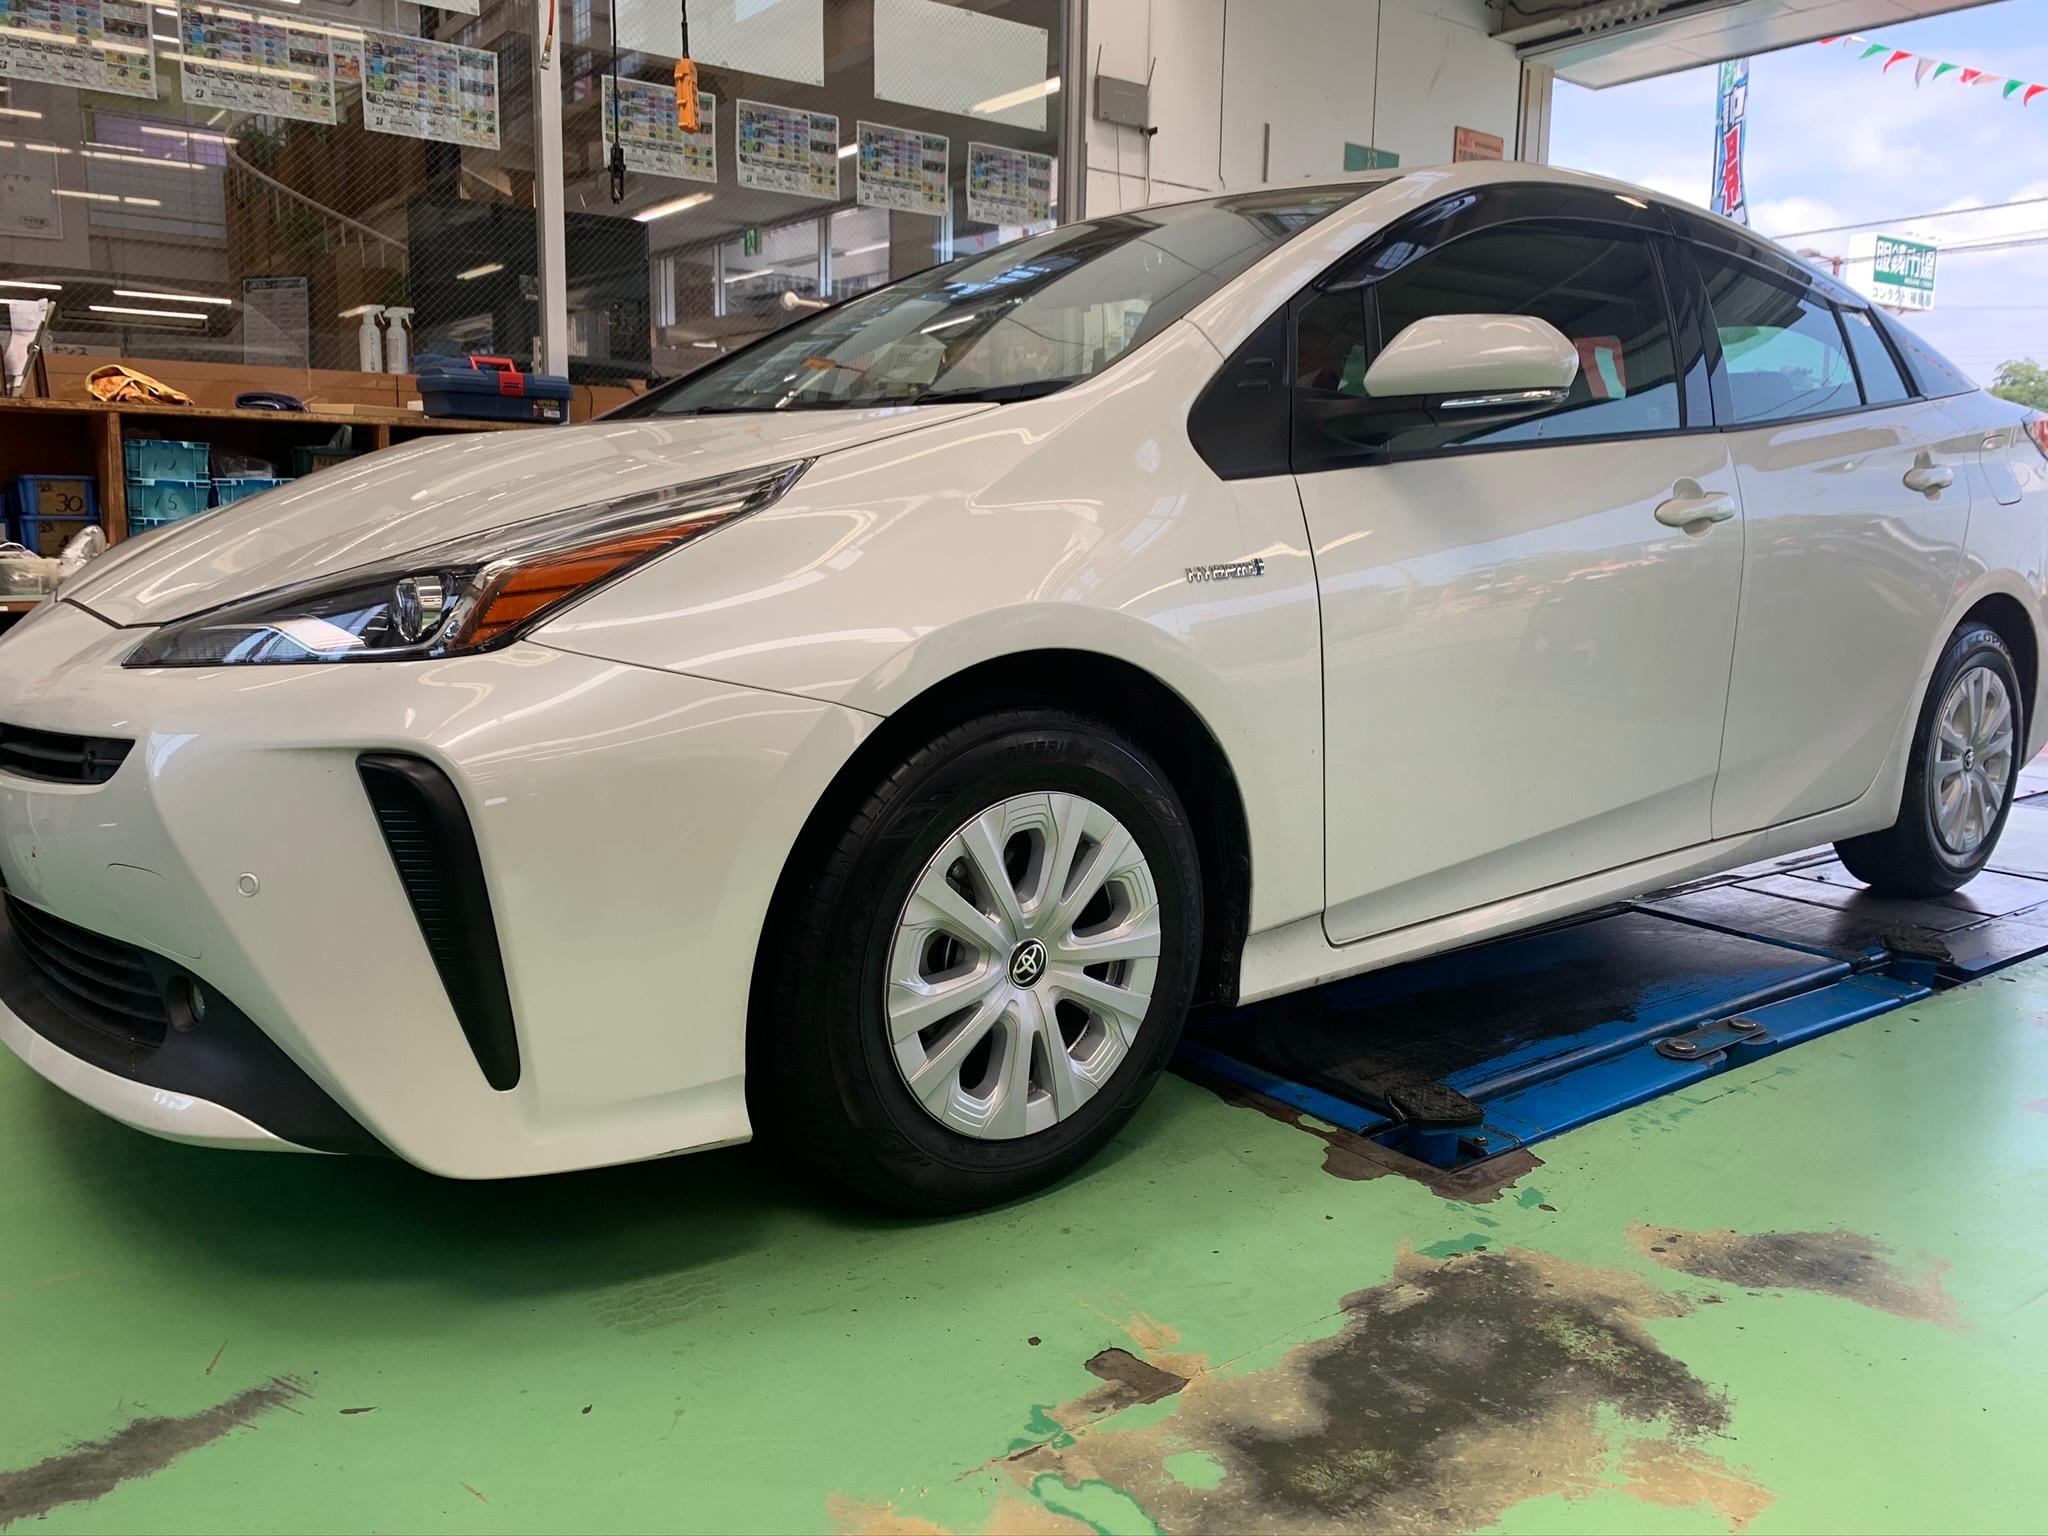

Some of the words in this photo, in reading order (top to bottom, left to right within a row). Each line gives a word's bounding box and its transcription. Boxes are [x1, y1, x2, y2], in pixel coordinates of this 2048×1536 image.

[1875, 241, 1935, 280] 眼鏡市場
[55, 493, 84, 513] 30
[154, 493, 178, 511] 15
